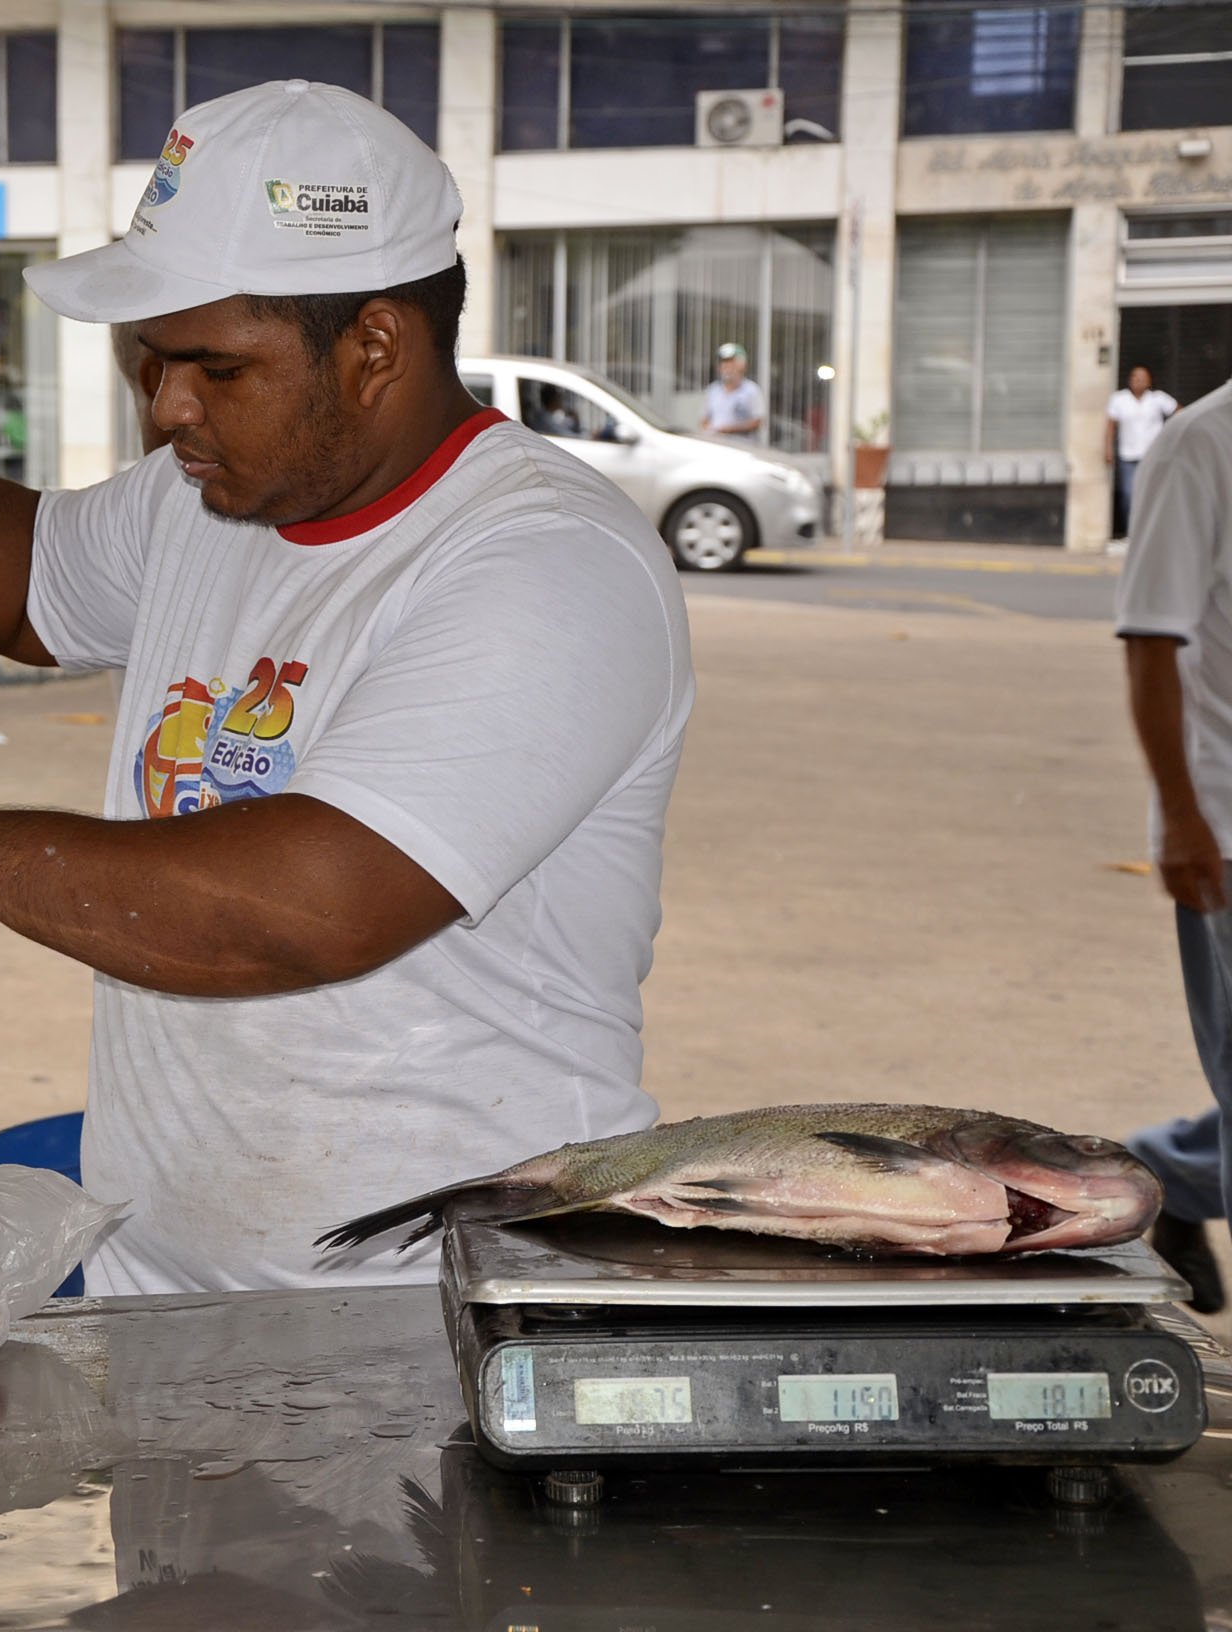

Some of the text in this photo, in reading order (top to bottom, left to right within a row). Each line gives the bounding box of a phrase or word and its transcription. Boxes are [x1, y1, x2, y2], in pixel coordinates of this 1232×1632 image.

[161, 128, 195, 166] 25
[298, 184, 368, 194] PREFEITURA DE
[296, 193, 369, 213] Cuiabá
[221, 657, 310, 741] 25
[210, 741, 272, 776] Edição
[1129, 1373, 1174, 1397] prix
[808, 1422, 869, 1434] Preço/kg R$
[1015, 1420, 1088, 1432] Preço Total R$
